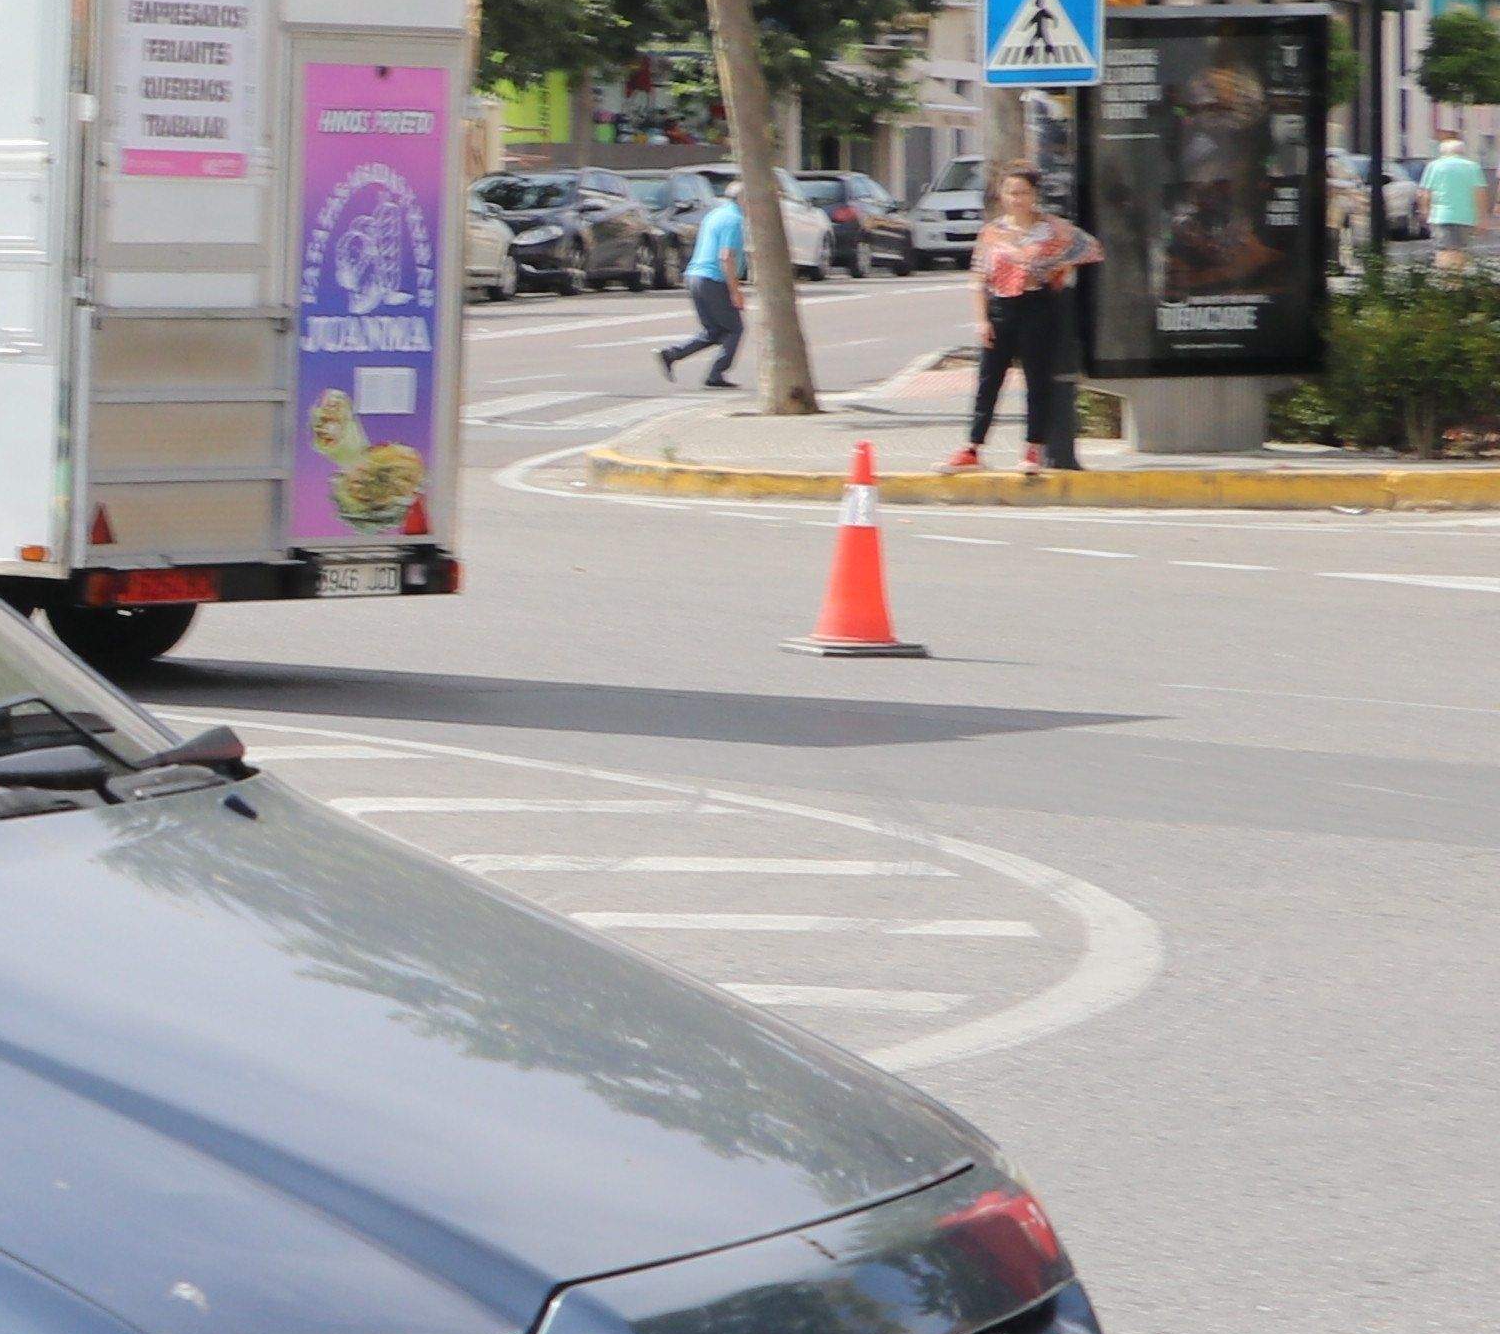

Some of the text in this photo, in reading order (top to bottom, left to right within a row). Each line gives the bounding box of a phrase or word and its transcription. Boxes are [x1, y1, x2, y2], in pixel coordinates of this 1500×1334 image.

[128, 0, 249, 29] EMPRESARIOS
[142, 37, 233, 66] FERIANTES
[140, 75, 233, 103] QUEREMOS
[140, 112, 230, 139] TRABAJAR
[300, 315, 433, 353] JUANMA
